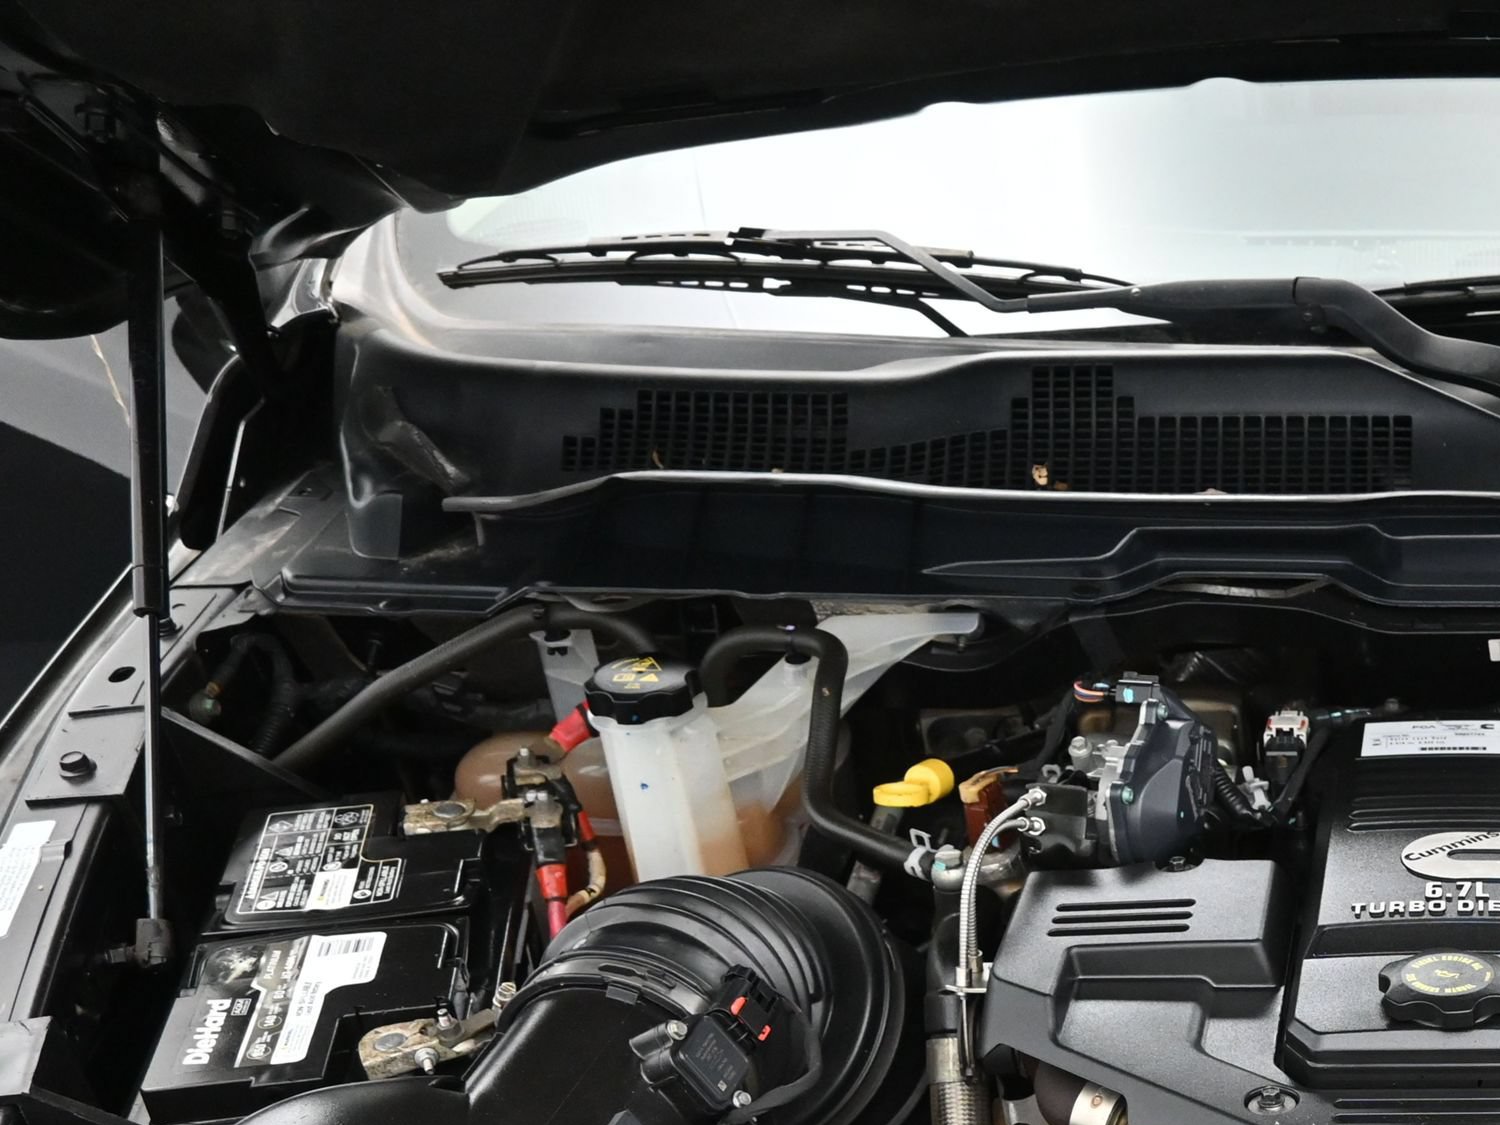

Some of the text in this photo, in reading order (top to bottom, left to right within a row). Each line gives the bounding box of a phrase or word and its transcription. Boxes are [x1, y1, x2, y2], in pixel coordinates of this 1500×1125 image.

[1403, 832, 1500, 862] Cummins
[1425, 881, 1490, 900] 6.7L
[1351, 899, 1447, 918] TURBO
[182, 997, 233, 1065] DieHard
